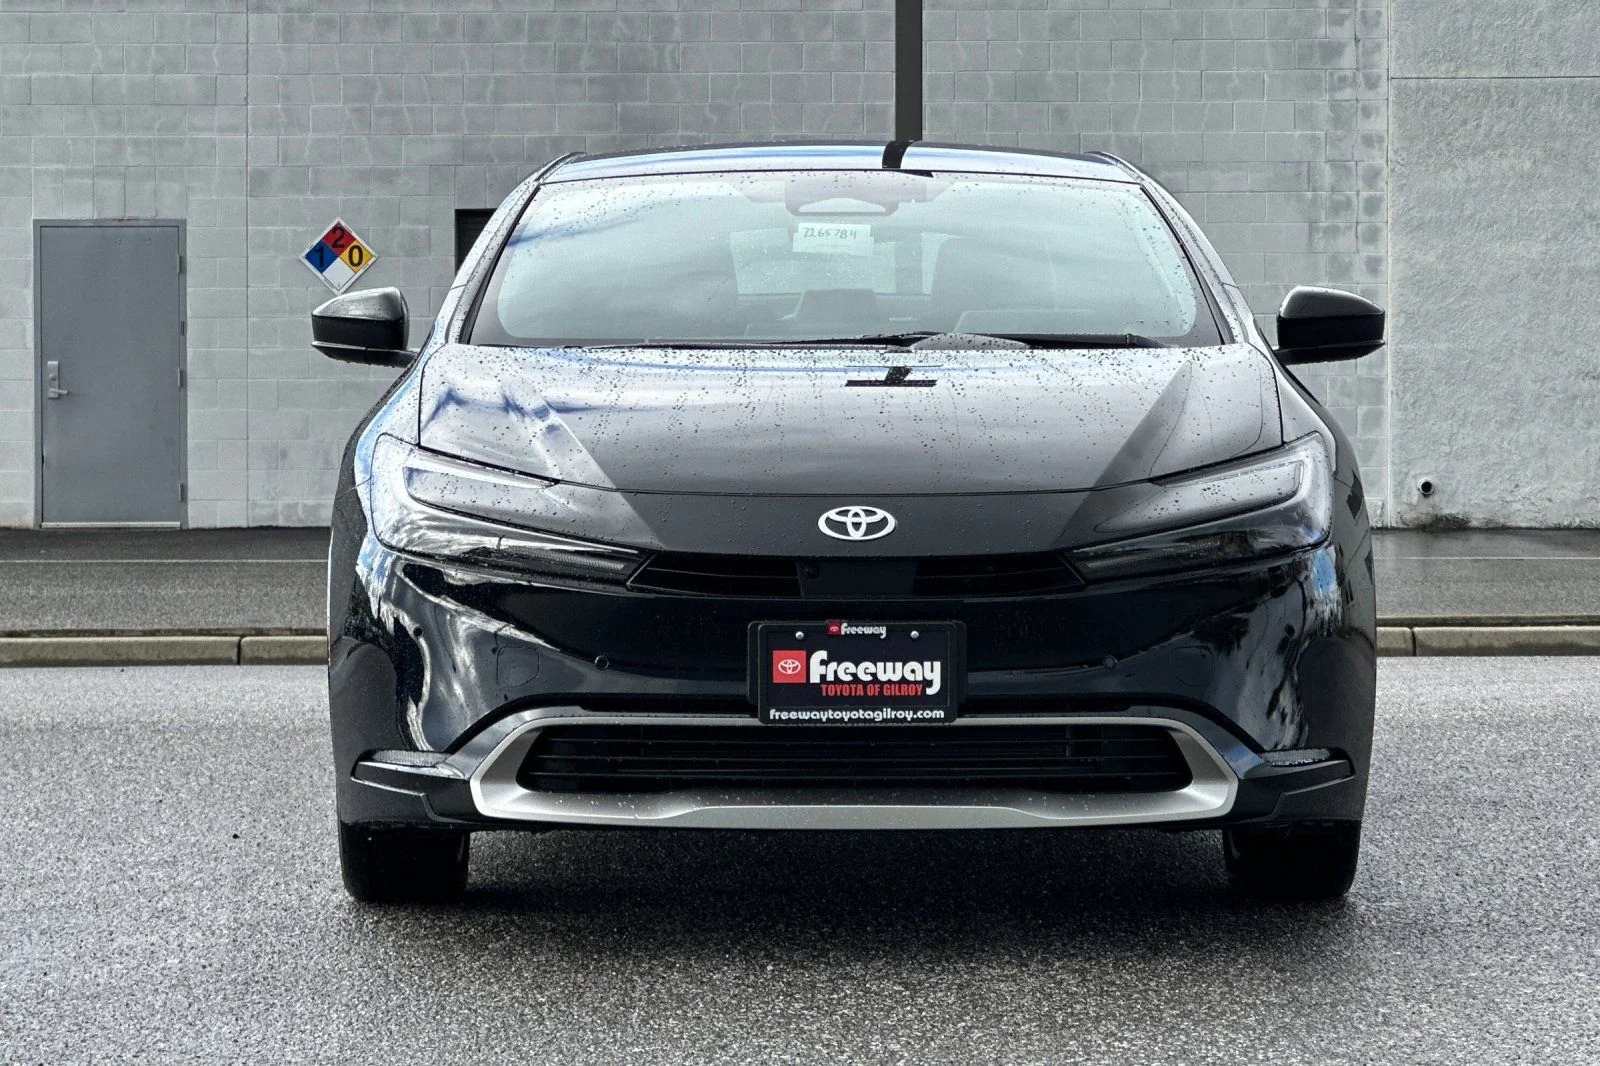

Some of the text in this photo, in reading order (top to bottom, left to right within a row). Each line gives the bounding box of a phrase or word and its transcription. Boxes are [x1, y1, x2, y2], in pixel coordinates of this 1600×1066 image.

[331, 225, 345, 248] 2
[314, 246, 325, 267] 1
[348, 245, 364, 267] 0
[840, 622, 887, 639] freeway
[809, 650, 941, 695] freeway
[820, 683, 923, 697] TOYOTA OF GILROY
[769, 708, 945, 722] freewaytoyotagilroy.com
